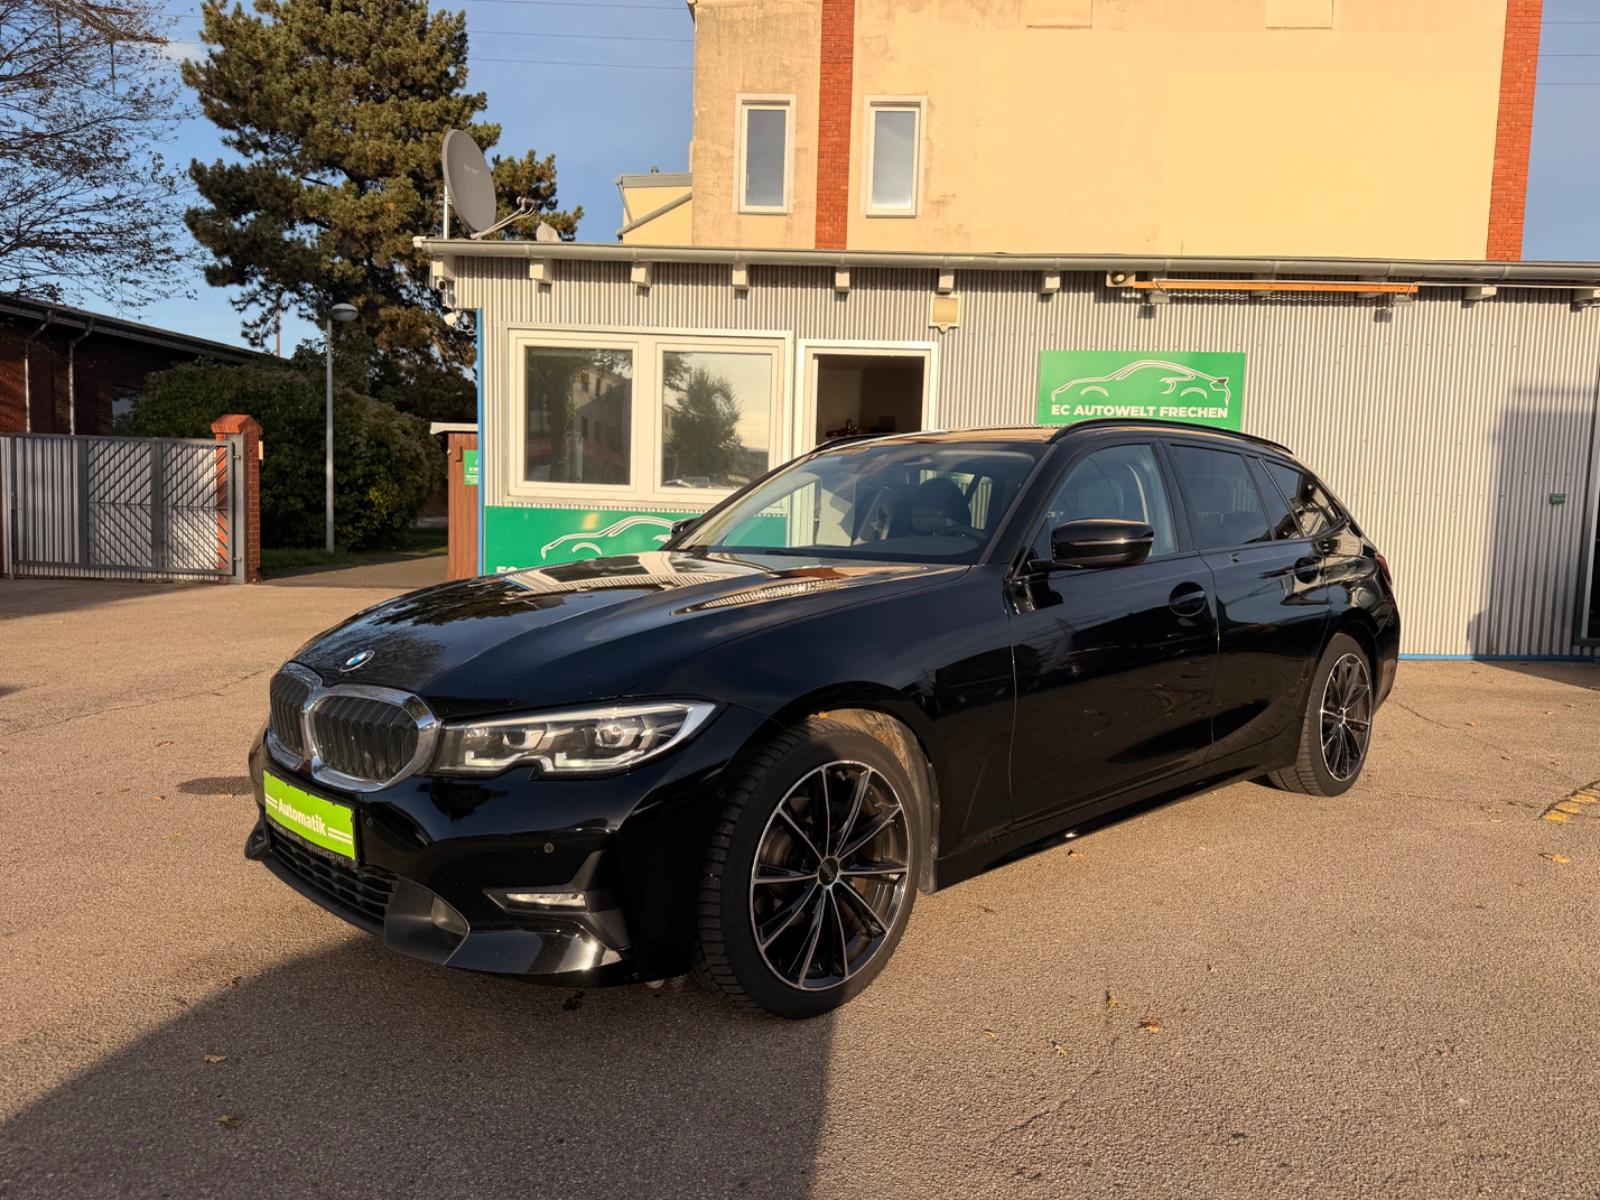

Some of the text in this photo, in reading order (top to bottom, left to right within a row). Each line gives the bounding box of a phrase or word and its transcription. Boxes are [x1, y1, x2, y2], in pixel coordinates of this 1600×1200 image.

[1051, 404, 1229, 418] EC AUTOWELT FRECHEN
[278, 797, 328, 837] Automatik
